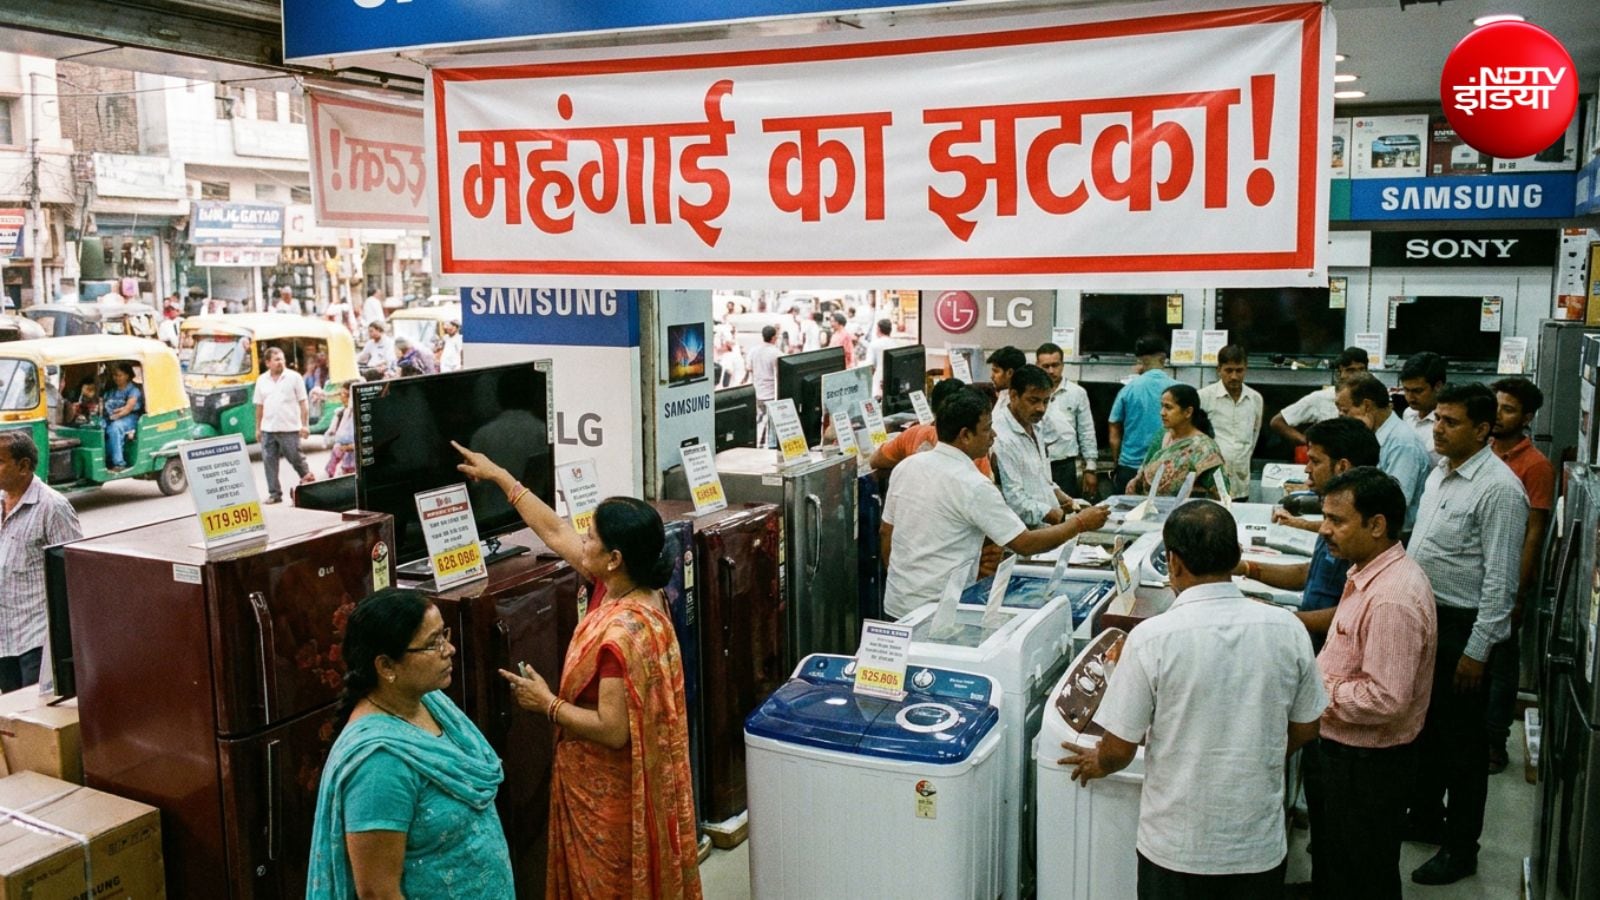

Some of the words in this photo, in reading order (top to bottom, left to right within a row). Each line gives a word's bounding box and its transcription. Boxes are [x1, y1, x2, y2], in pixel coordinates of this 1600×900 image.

[458, 80, 736, 248] महंगाई
[762, 111, 893, 223] का
[923, 73, 1276, 242] झटका!
[1381, 184, 1543, 211] SAMSUNG
[1406, 239, 1519, 259] SONY
[470, 287, 617, 317] SAMSUNG
[986, 296, 1033, 328] LG
[664, 394, 711, 419] SAMSUNG
[556, 411, 603, 447] LG
